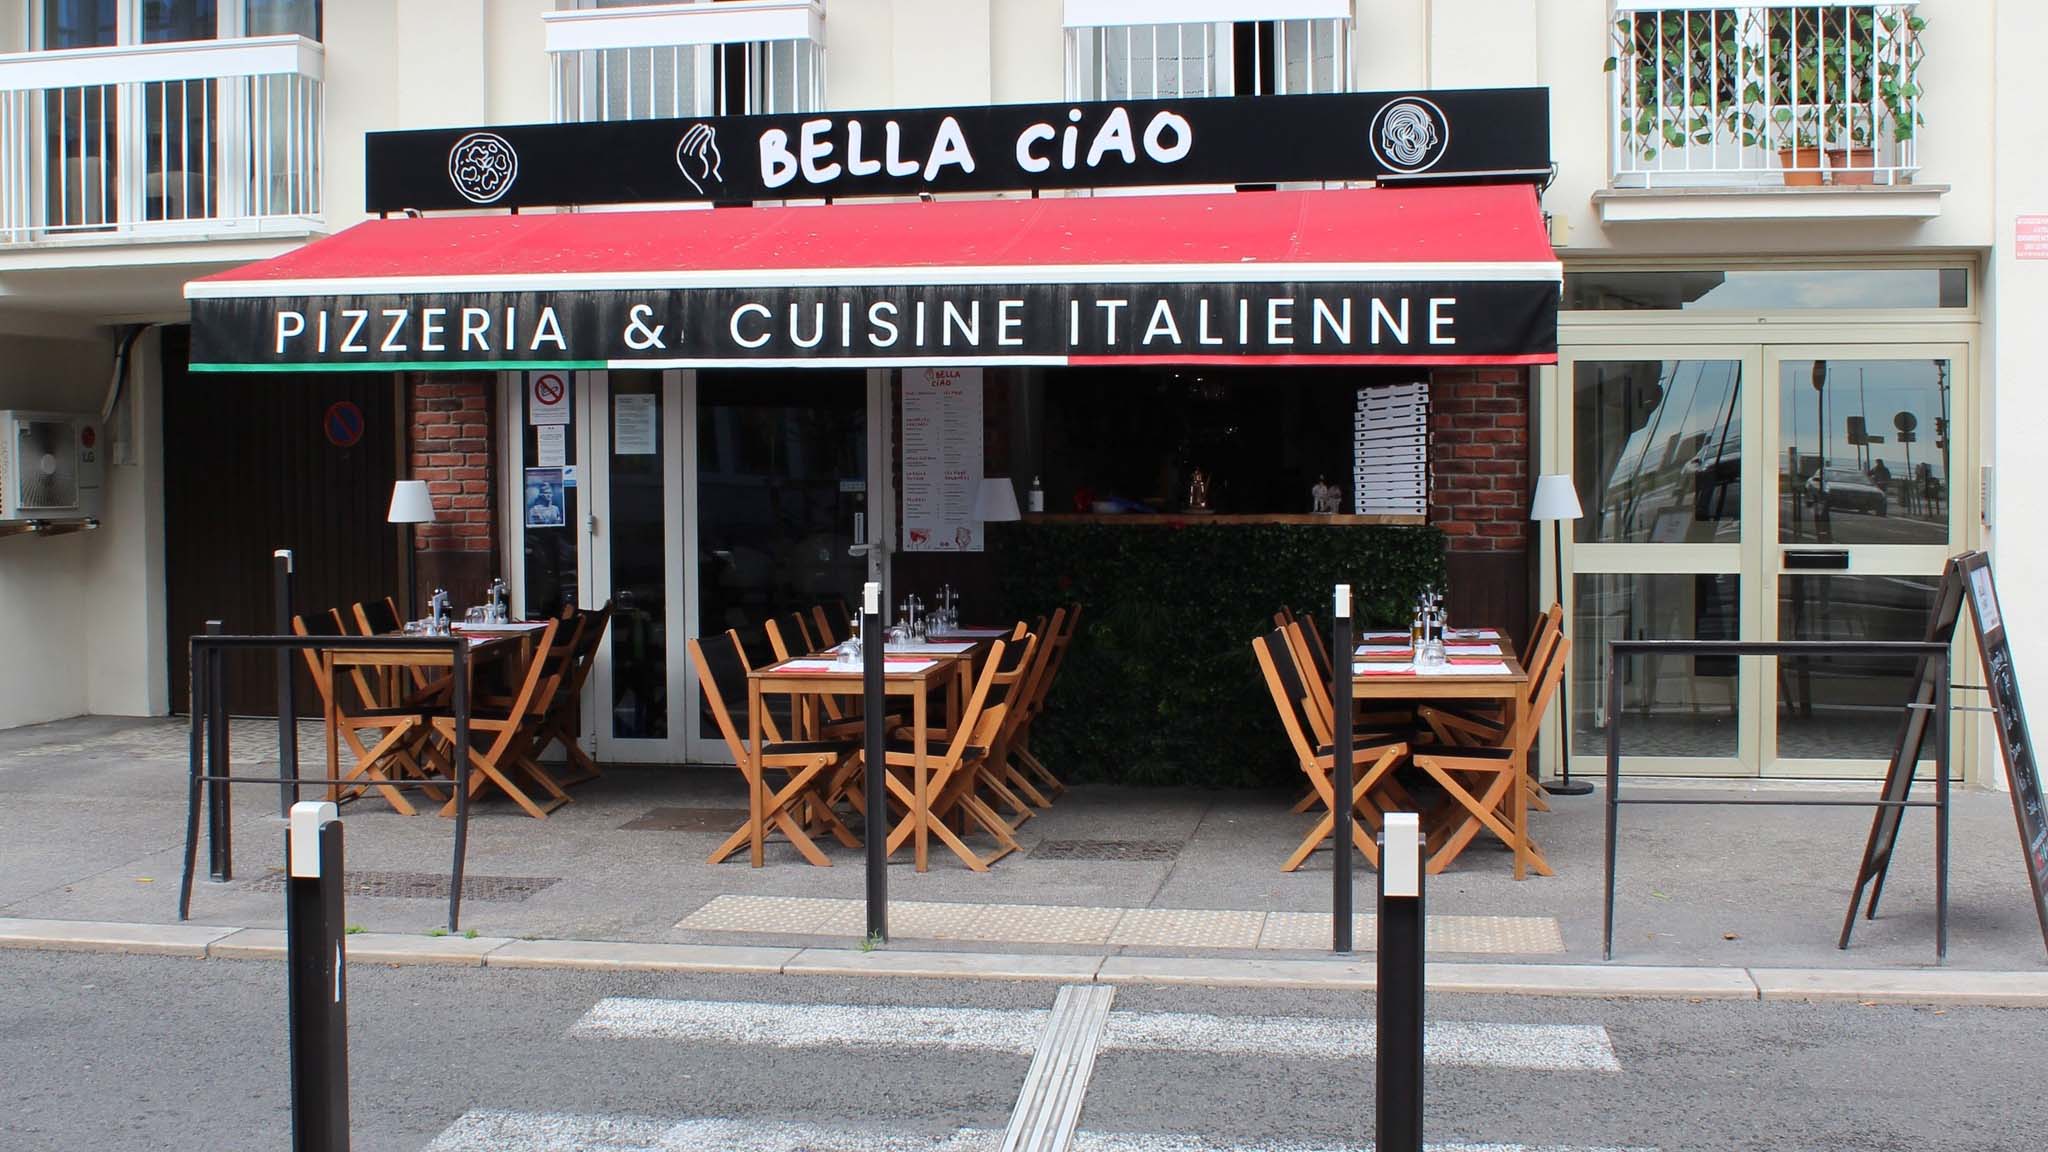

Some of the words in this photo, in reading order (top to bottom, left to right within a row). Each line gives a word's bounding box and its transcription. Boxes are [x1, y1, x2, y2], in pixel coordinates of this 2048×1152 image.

[759, 116, 976, 188] BELLA
[276, 306, 567, 354] PIZZERIA
[623, 304, 667, 350] &
[730, 301, 1024, 348] CUISINE
[1070, 297, 1456, 346] ITALIENNE
[935, 370, 961, 379] BELLA
